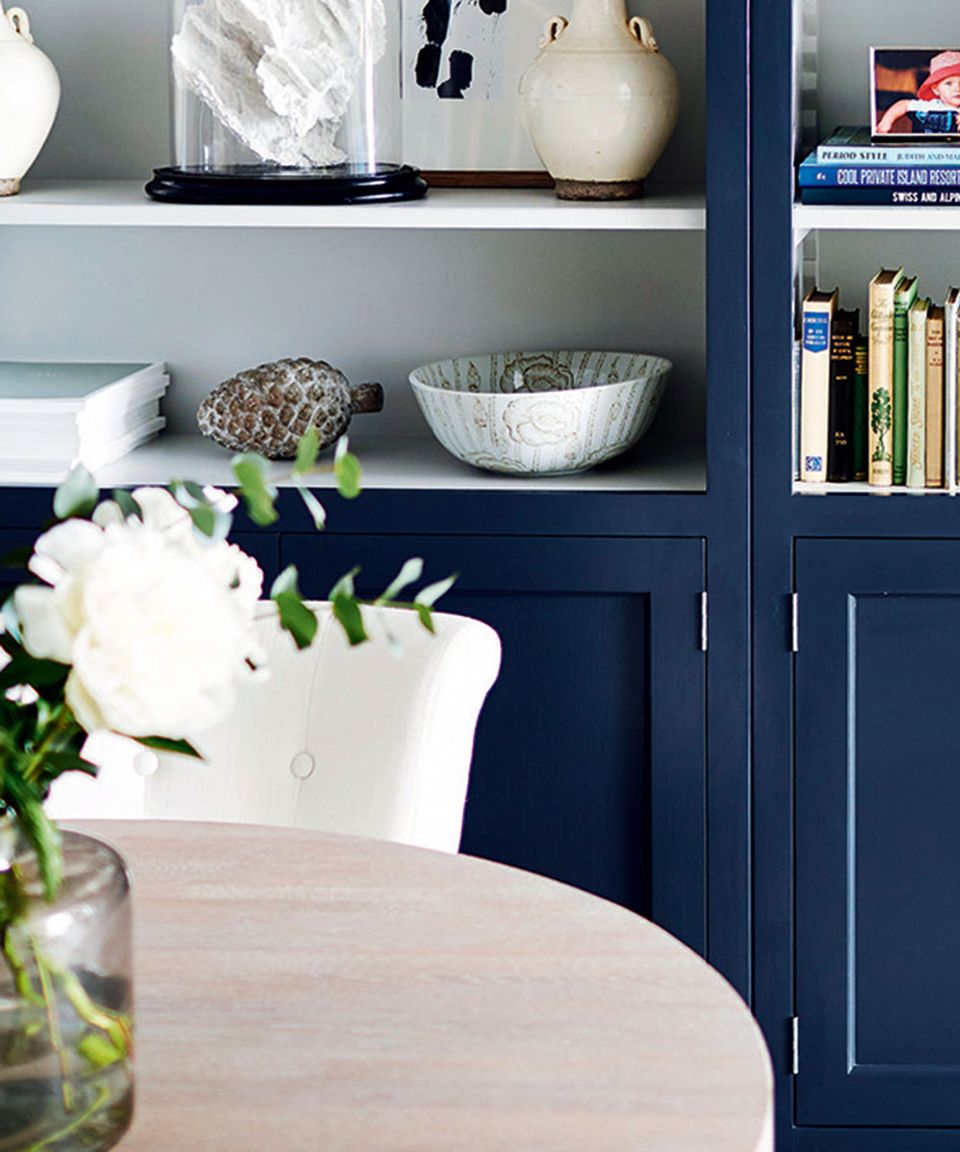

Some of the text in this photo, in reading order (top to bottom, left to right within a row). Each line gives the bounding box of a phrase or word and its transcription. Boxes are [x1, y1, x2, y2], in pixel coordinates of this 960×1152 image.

[822, 151, 857, 160] PERIOD
[860, 152, 887, 160] STYLE
[896, 153, 925, 161] JUDITH
[837, 169, 859, 185] COOL
[860, 169, 895, 185] PRIVATE
[897, 169, 928, 186] ISLAND
[892, 192, 919, 203] SWISS
[920, 192, 938, 203] AND
